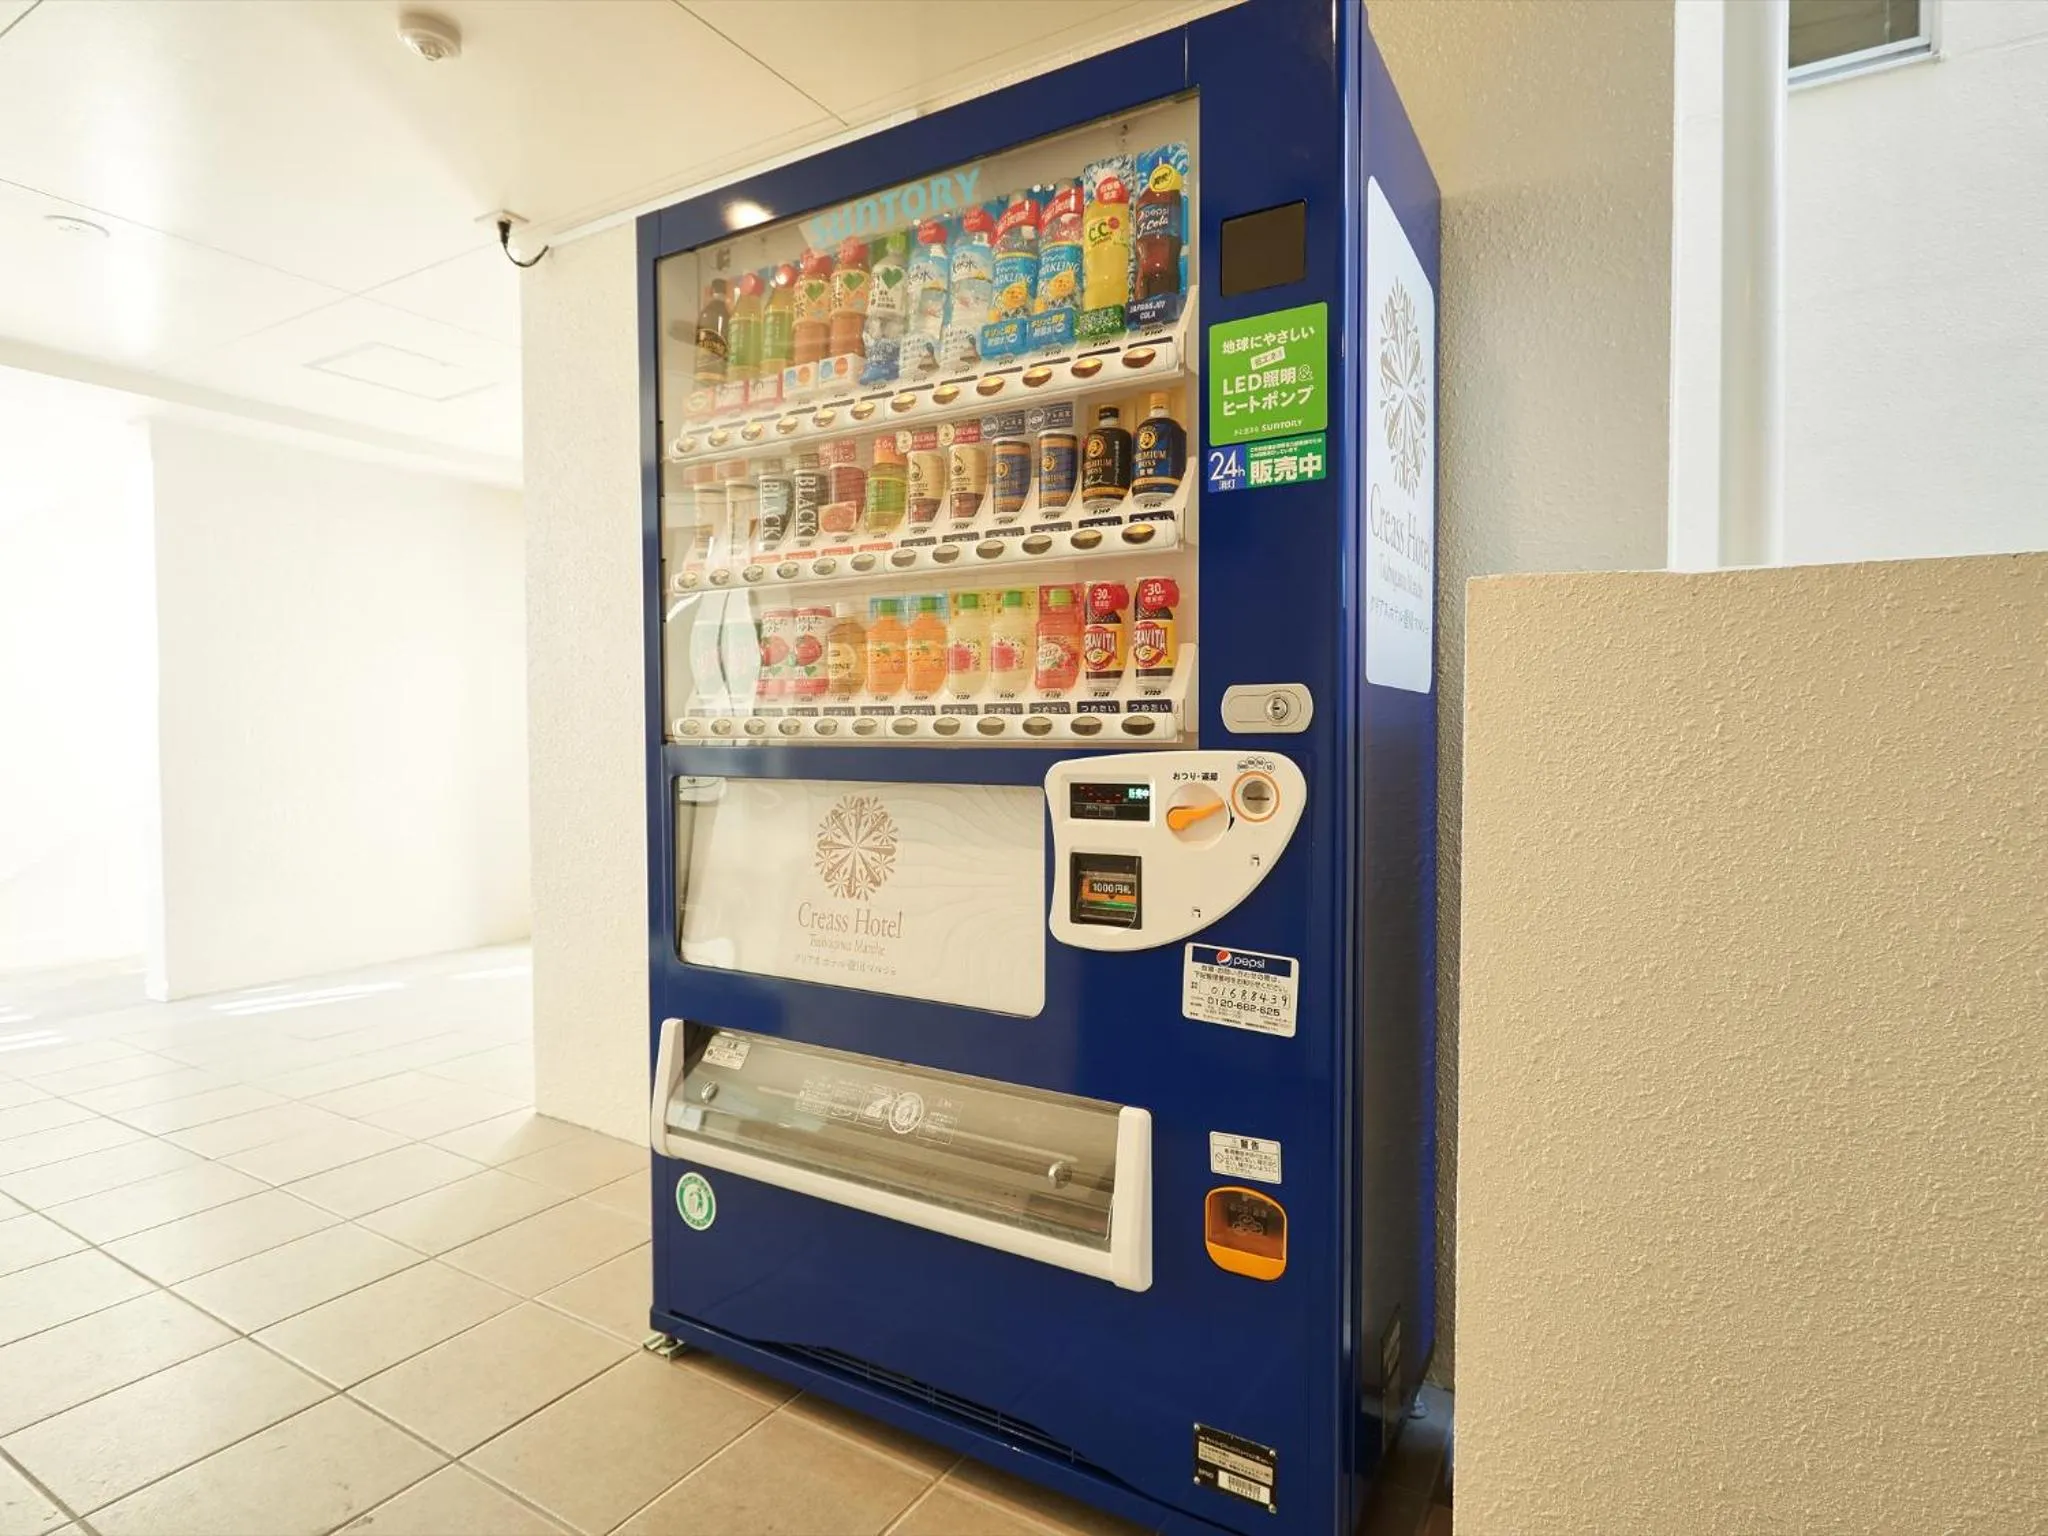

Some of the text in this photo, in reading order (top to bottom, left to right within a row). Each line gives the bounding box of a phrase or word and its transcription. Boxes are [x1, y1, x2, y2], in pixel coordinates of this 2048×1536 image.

[810, 166, 981, 251] SUNTORY
[1222, 326, 1316, 354] 地球にやさしい
[1223, 385, 1315, 416] ヒートポンプ
[1261, 418, 1303, 432] SUNTORY
[1210, 449, 1246, 481] 24h
[1250, 452, 1323, 485] 販売中
[798, 475, 818, 537] BLACK
[1080, 704, 1117, 714] つめたい
[1131, 703, 1169, 714] つめたい
[1173, 771, 1219, 782] おつり・返却
[798, 901, 902, 939] Creass Hotel
[1233, 956, 1266, 969] pepsi
